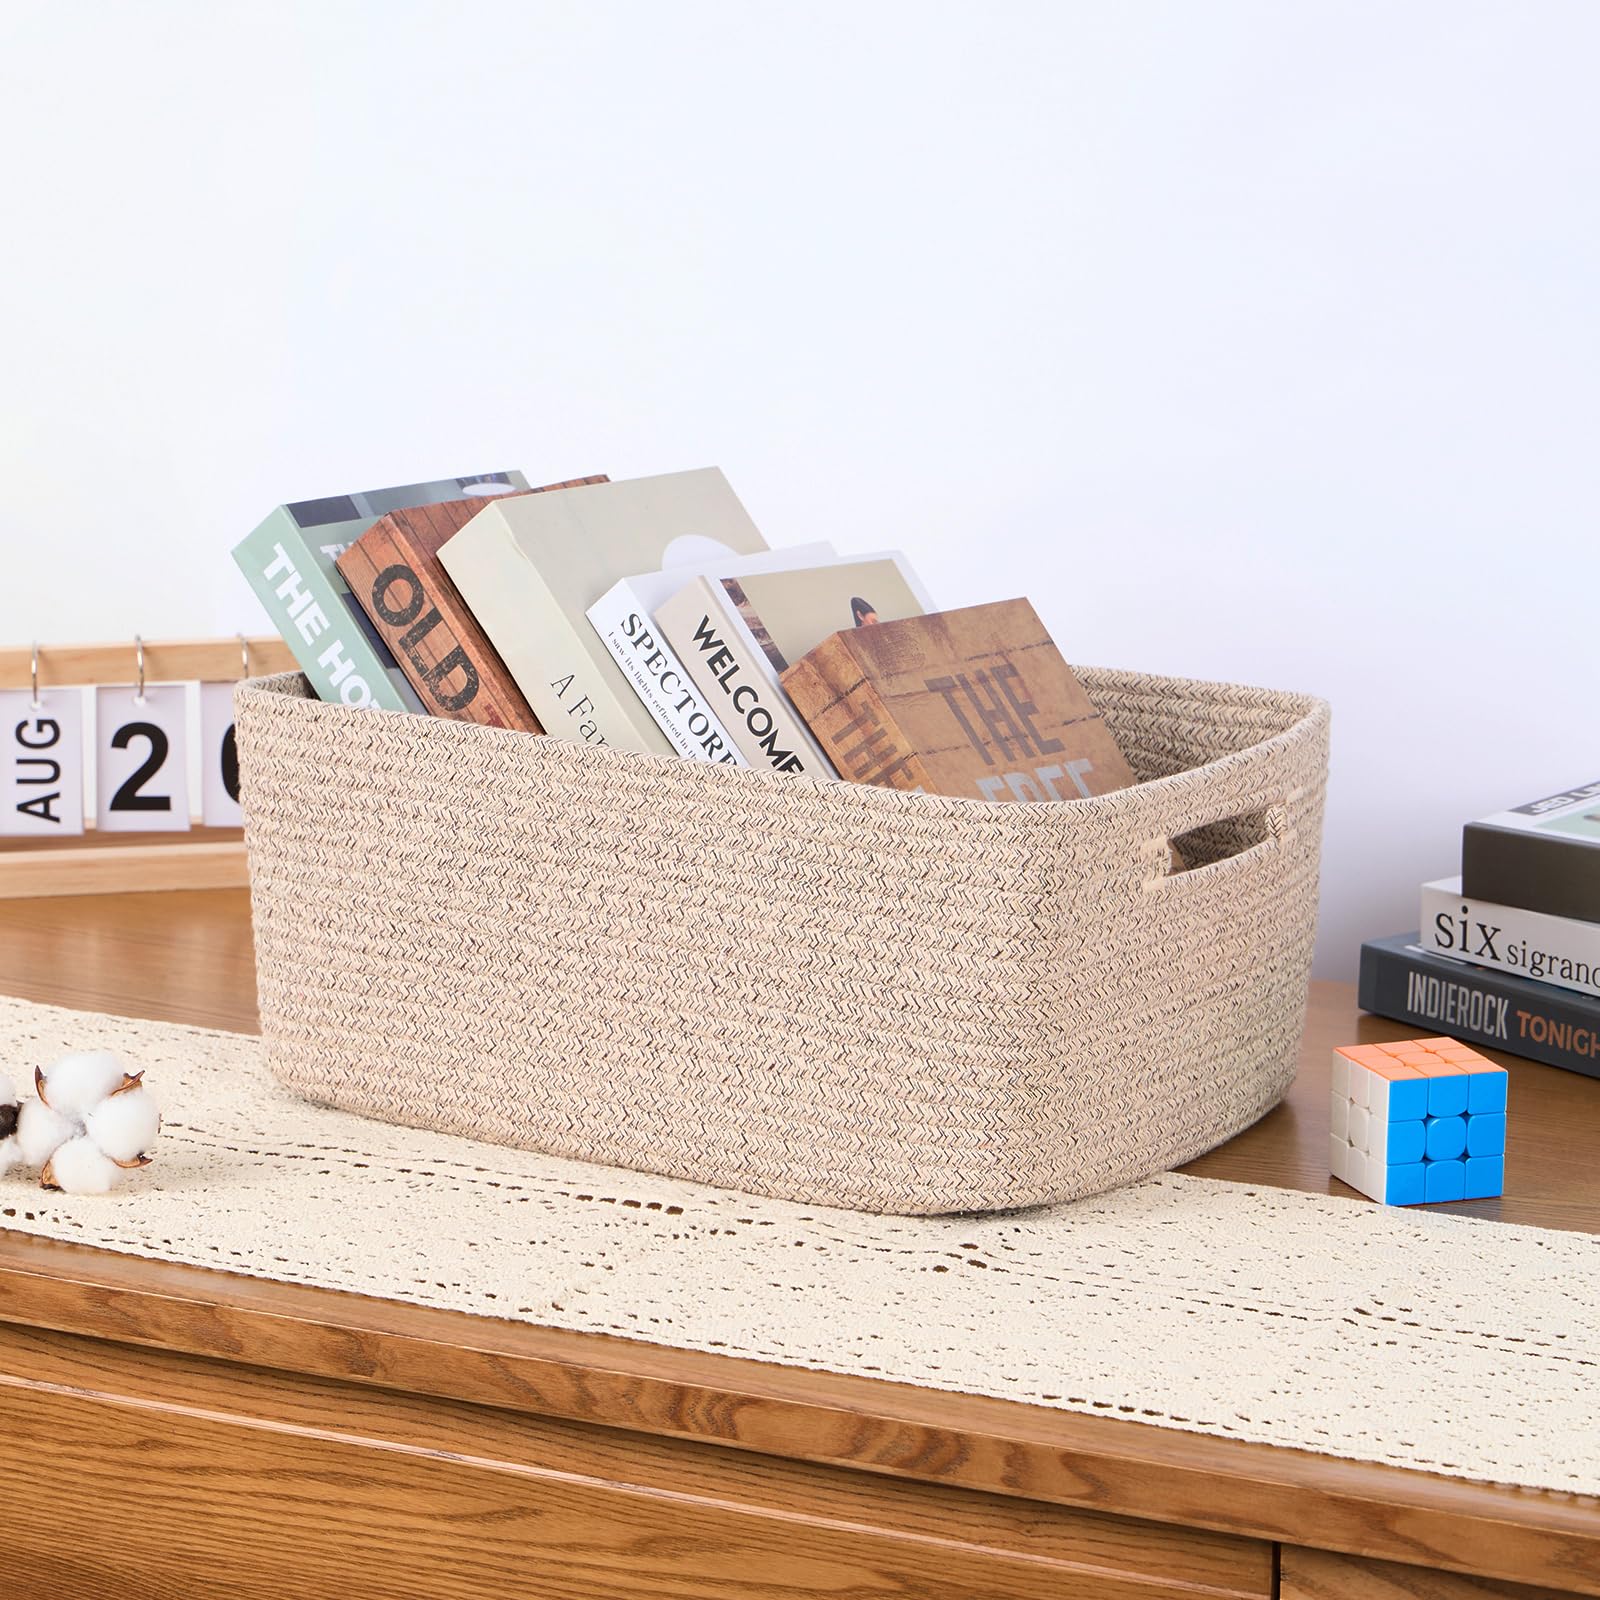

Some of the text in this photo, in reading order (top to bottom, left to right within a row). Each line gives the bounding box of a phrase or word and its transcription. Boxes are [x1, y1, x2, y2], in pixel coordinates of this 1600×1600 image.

[263, 541, 331, 647] THE
[317, 639, 381, 709] HO
[372, 564, 480, 712] OLD
[550, 674, 575, 699] A
[612, 638, 625, 656] saw
[624, 656, 634, 672] its
[634, 671, 652, 698] lights
[652, 699, 682, 739] reflected
[680, 738, 689, 750] in
[692, 614, 805, 774] WELCOME
[924, 663, 1066, 766] THE
[15, 718, 61, 823] AUG
[109, 721, 172, 812] 2
[831, 700, 914, 789] THE
[1407, 971, 1509, 1040] INDIEROCK
